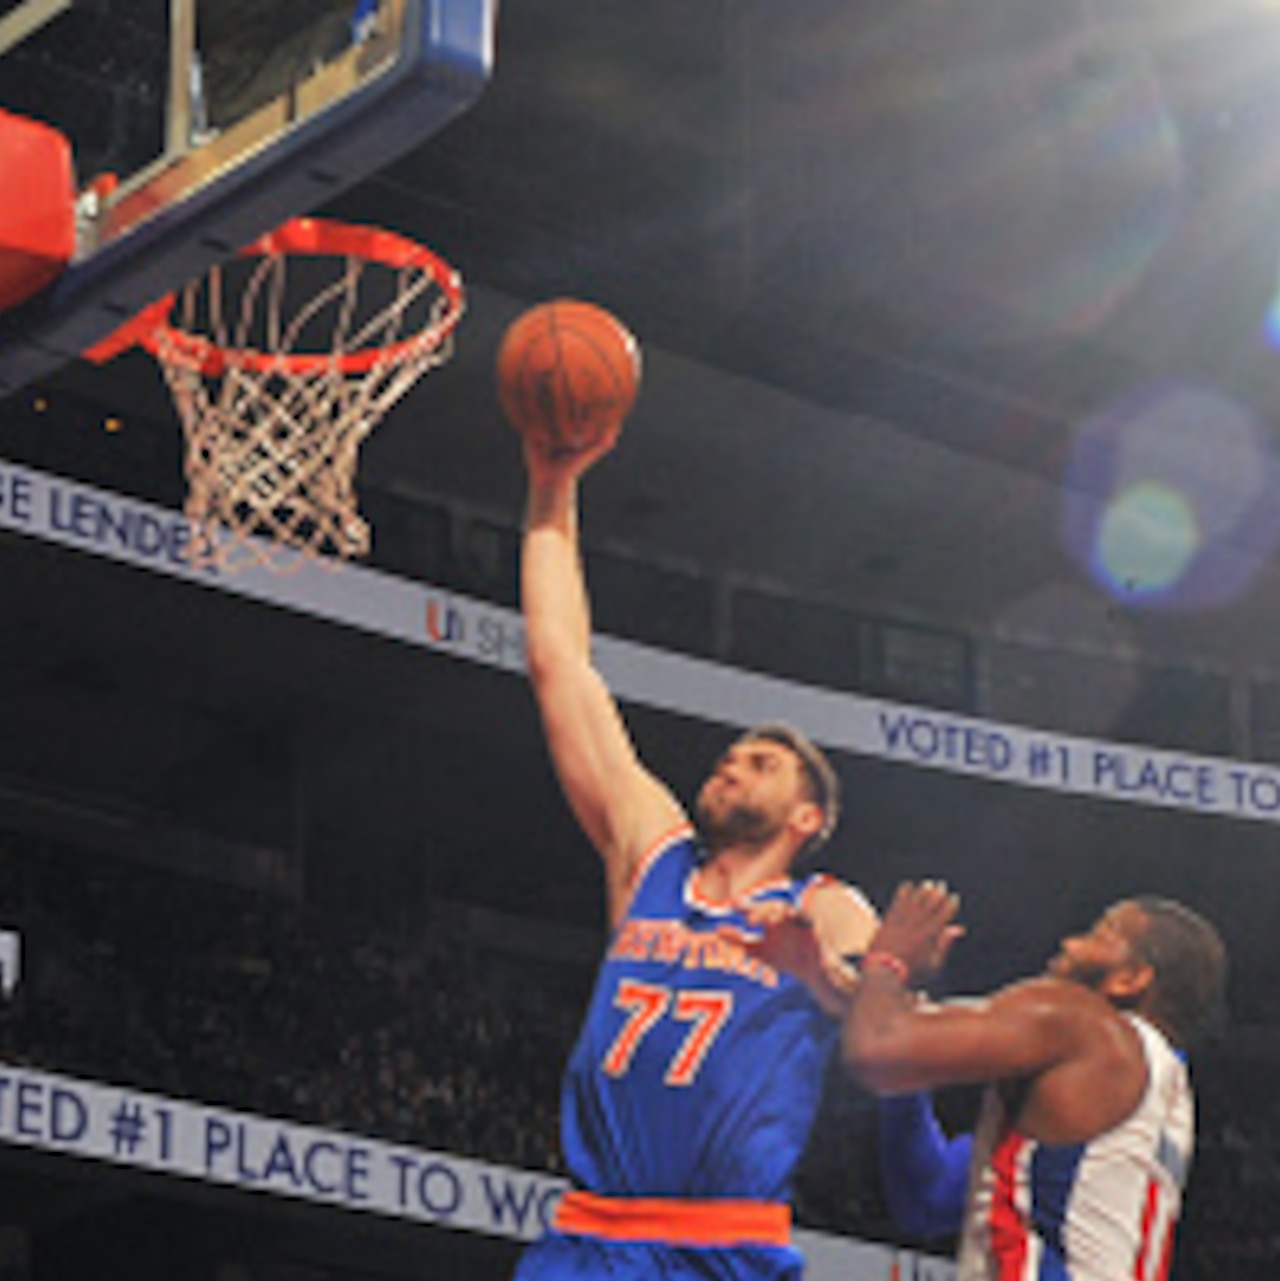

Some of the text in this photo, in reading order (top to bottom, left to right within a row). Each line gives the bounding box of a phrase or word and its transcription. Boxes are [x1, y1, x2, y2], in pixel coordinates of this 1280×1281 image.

[879, 711, 1011, 773] VOTED
[1028, 747, 1071, 783] #1
[1092, 752, 1216, 806] PLACE
[602, 977, 733, 1087] 77
[110, 1103, 173, 1162] #1
[204, 1115, 370, 1201] PLACE
[388, 1156, 462, 1217] TO
